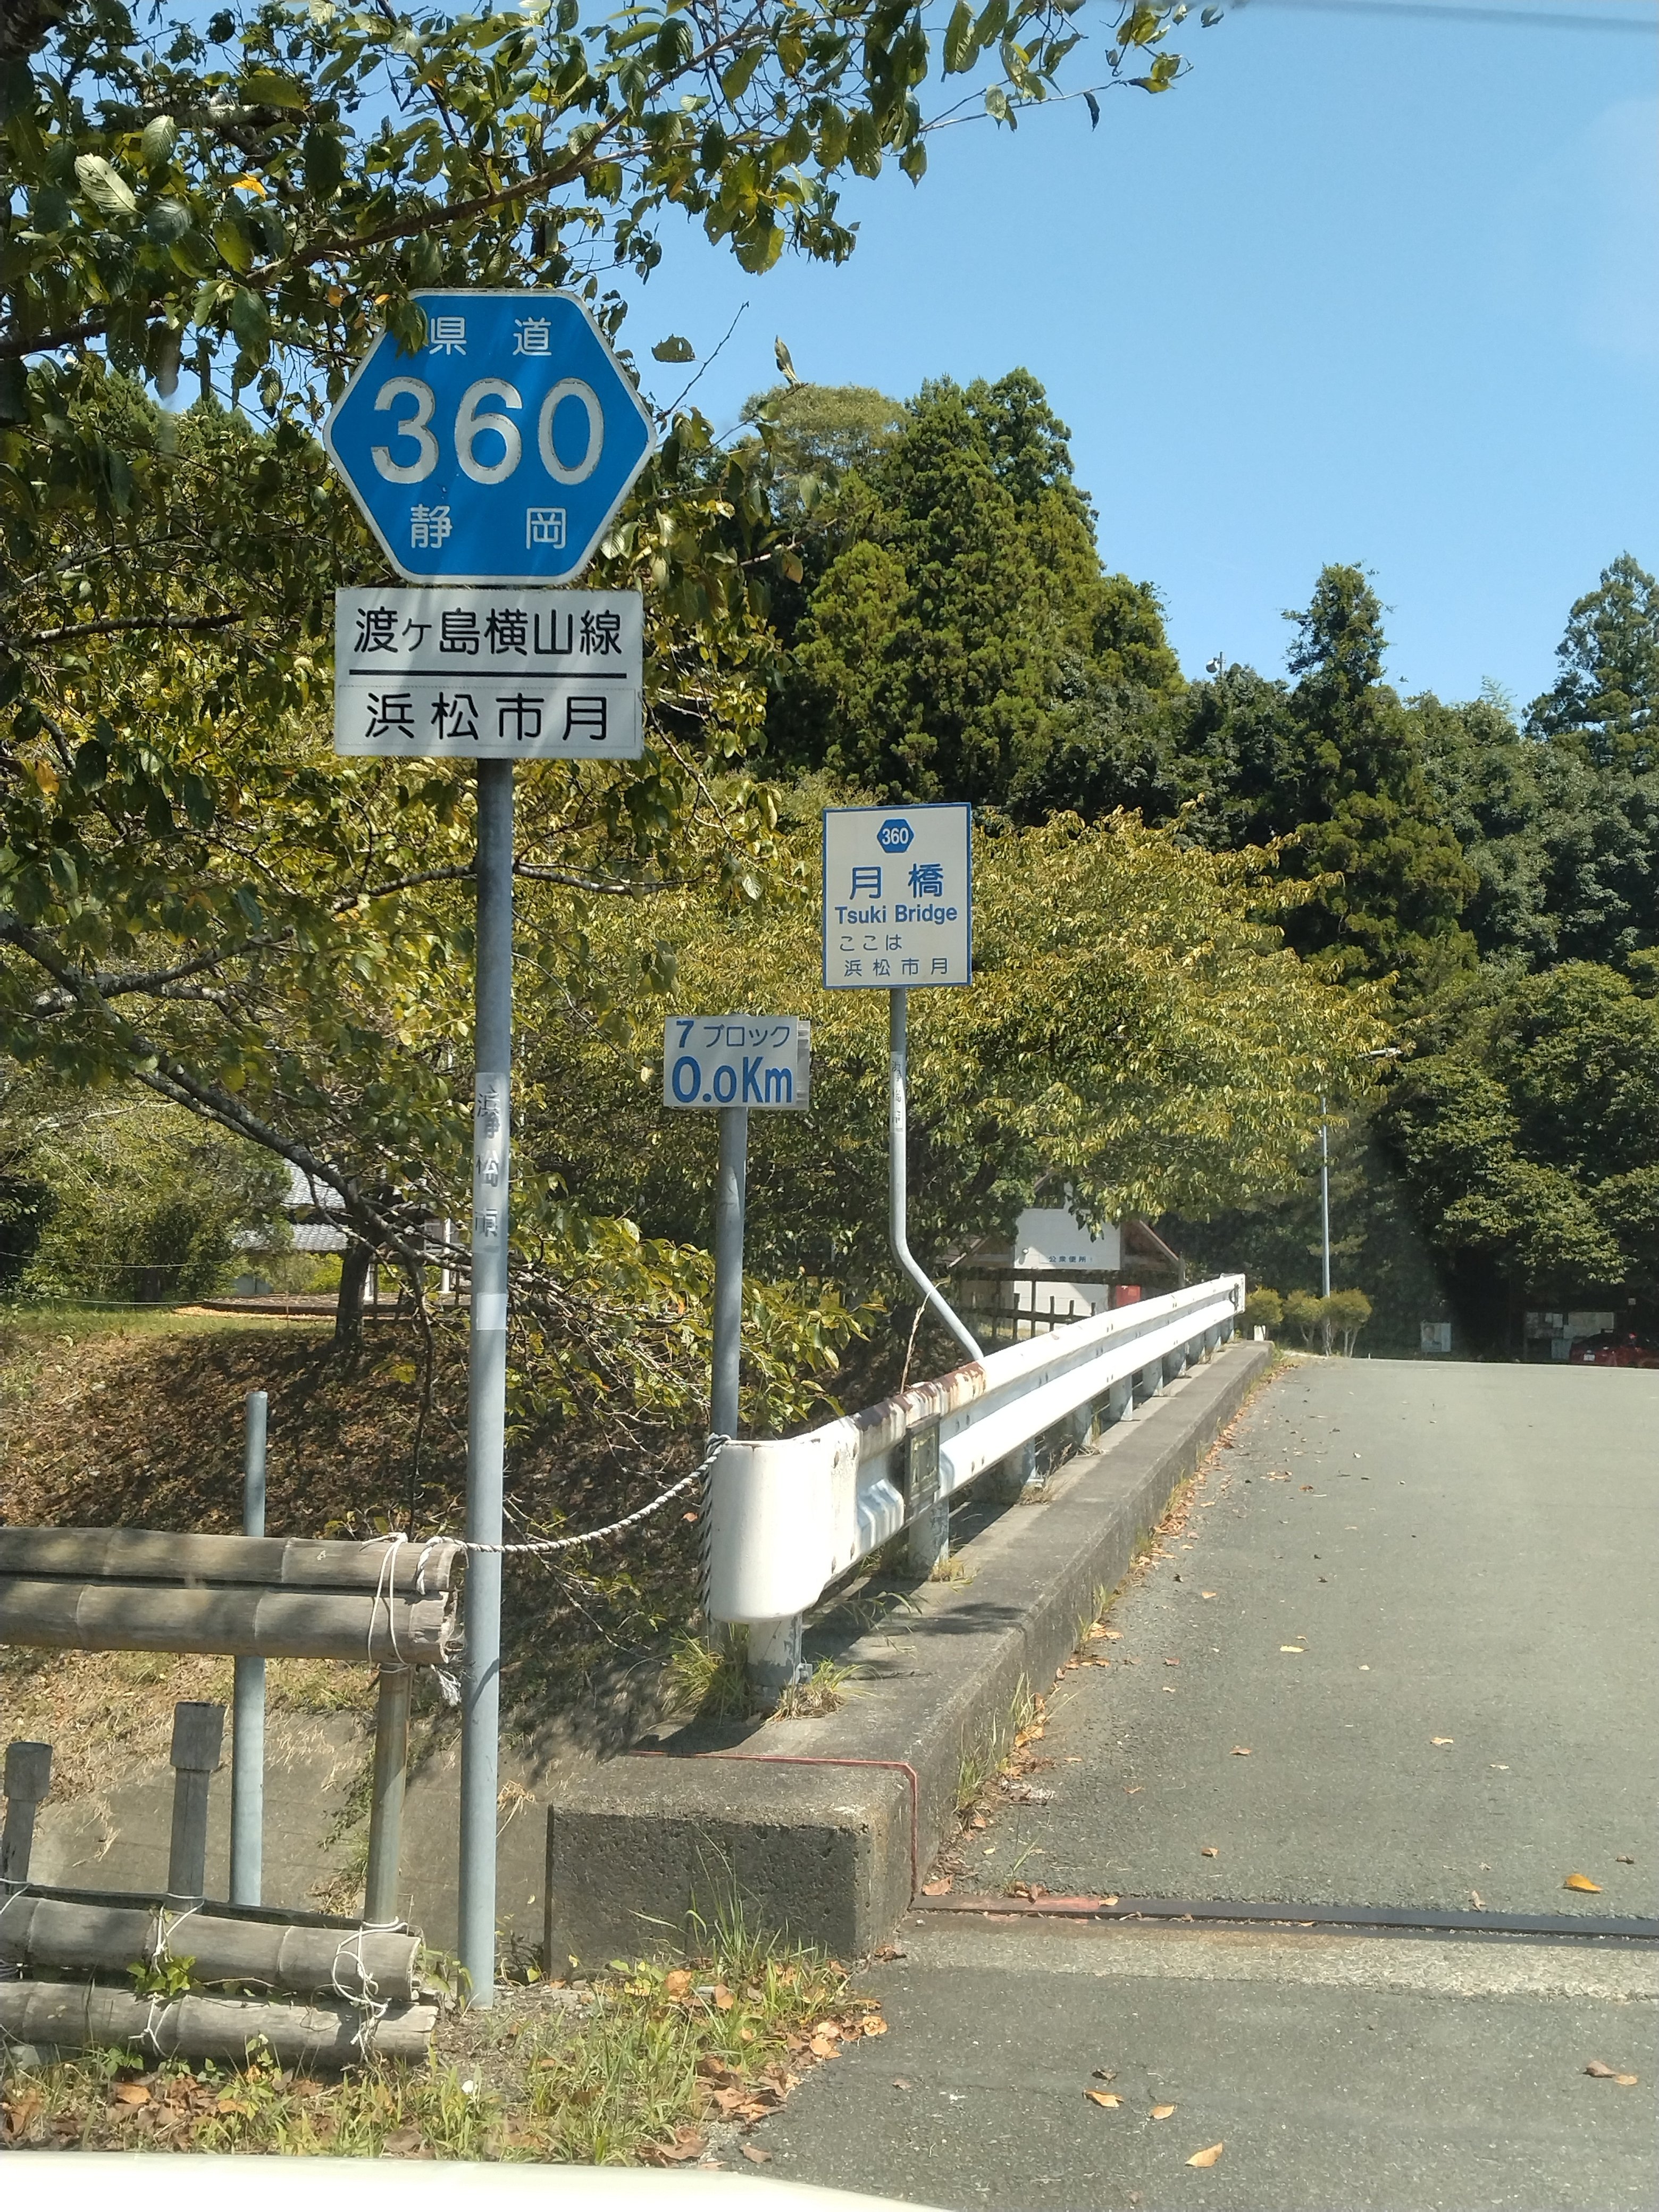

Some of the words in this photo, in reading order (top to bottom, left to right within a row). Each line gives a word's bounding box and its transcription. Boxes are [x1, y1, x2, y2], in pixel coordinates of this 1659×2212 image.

[371, 376, 605, 485] 360
[365, 692, 607, 741] 浜松市月
[882, 827, 909, 845] 360
[849, 863, 944, 900] 月橋
[834, 905, 886, 924] Tsuki
[895, 903, 958, 925] Bridge
[839, 934, 903, 951] ここは
[844, 958, 948, 977] 浜松市月
